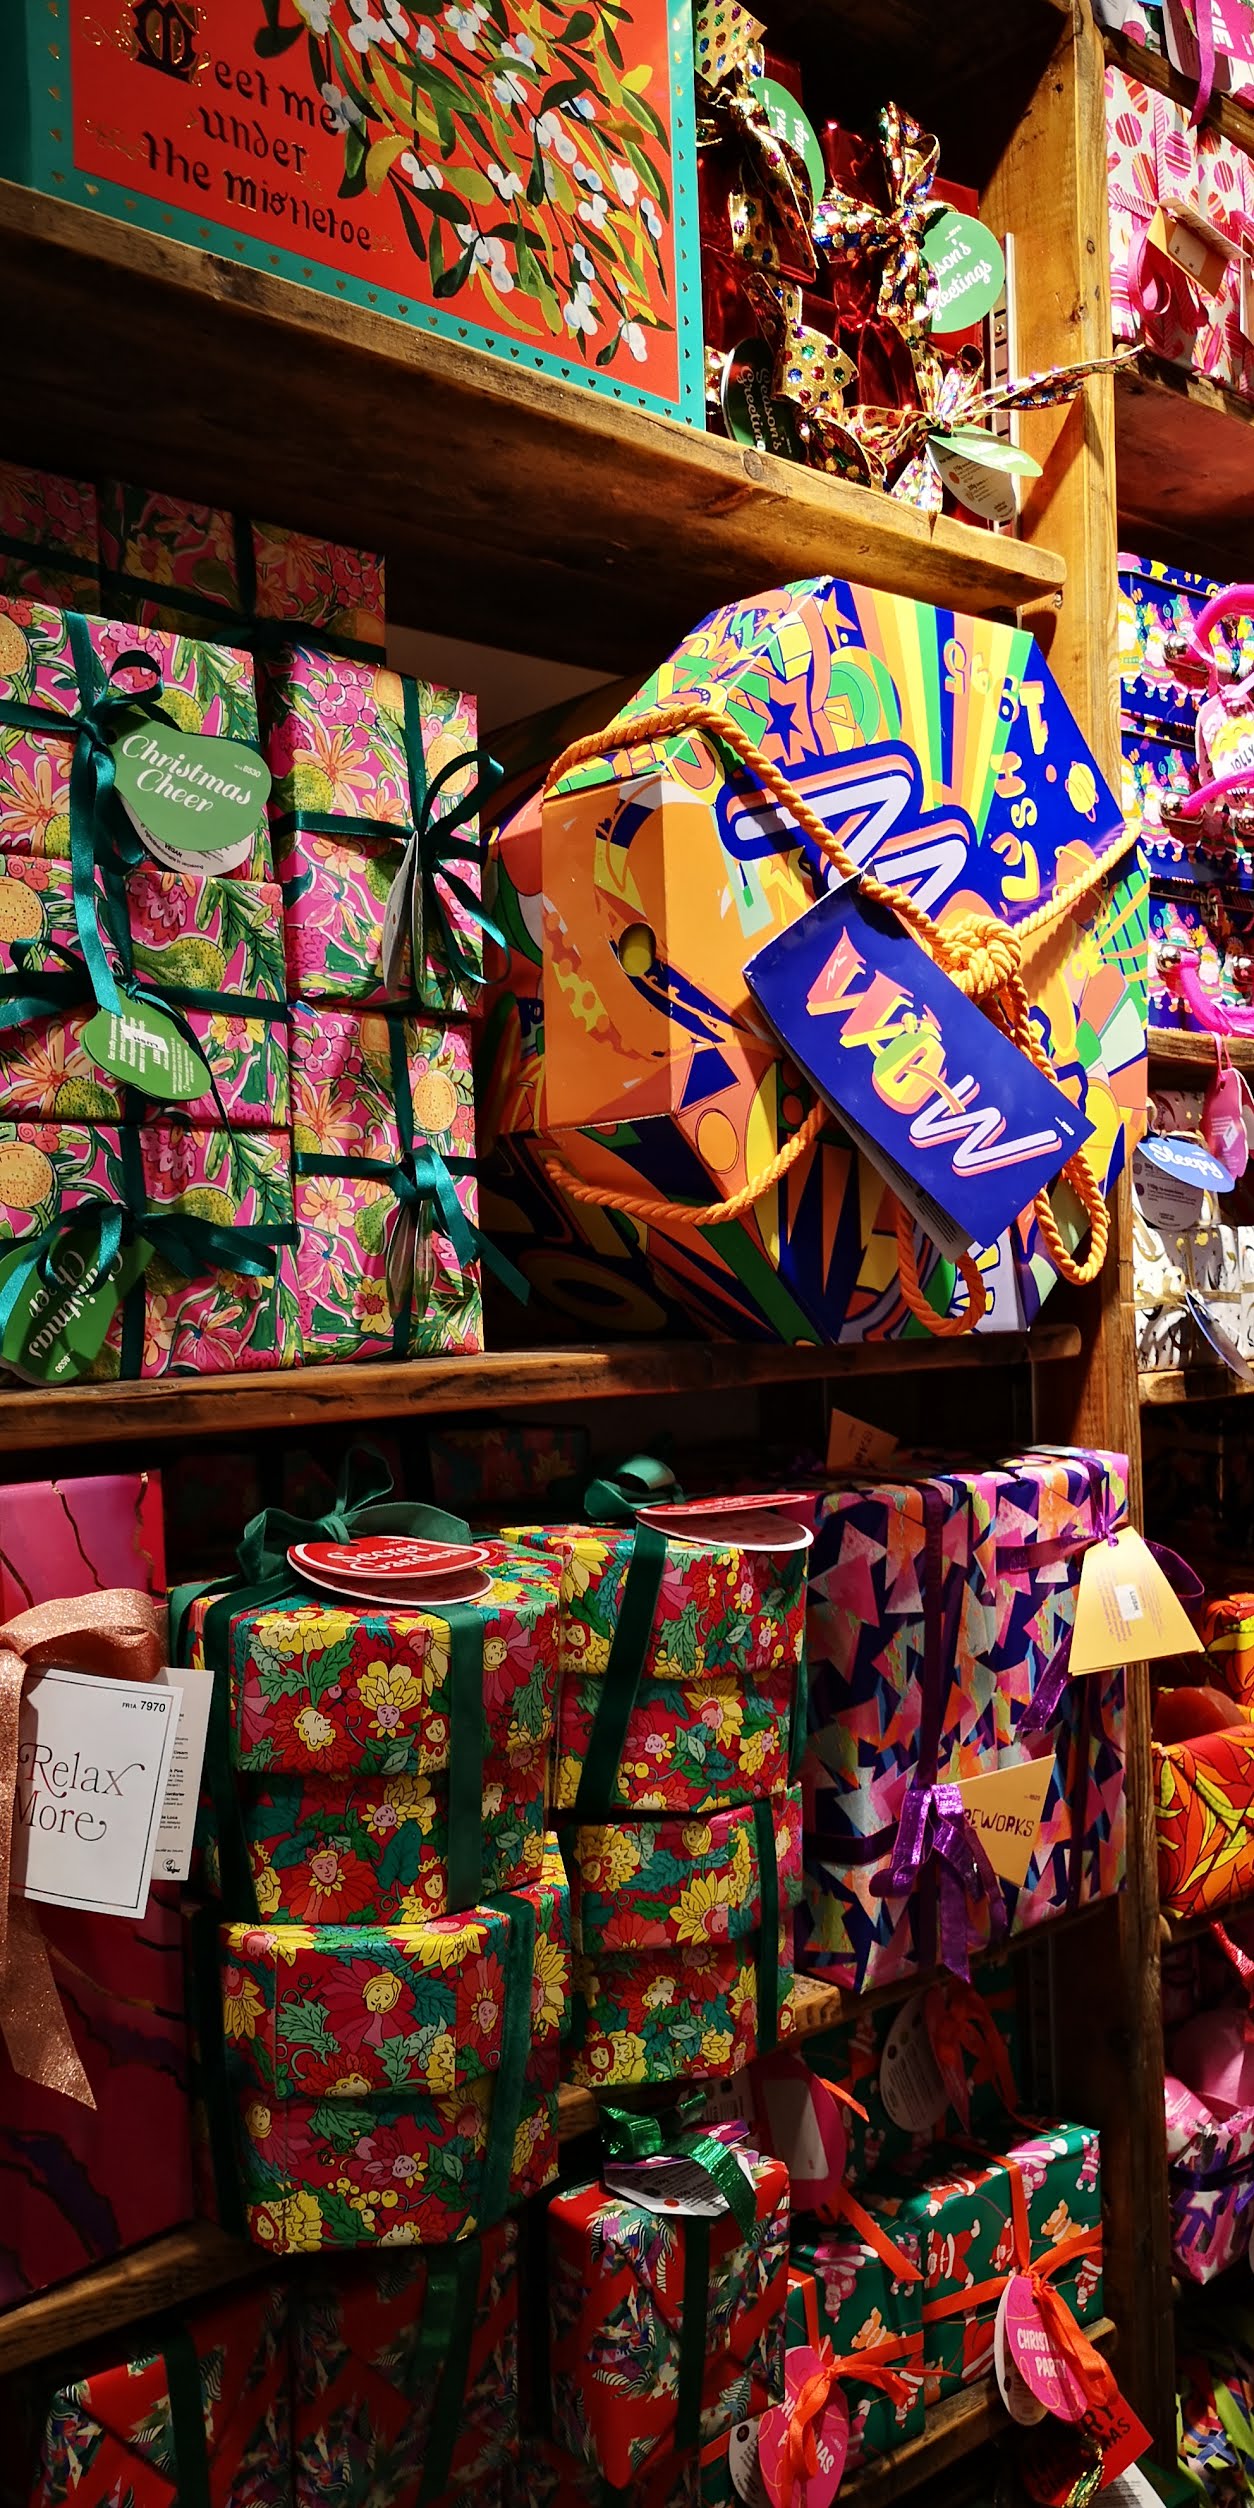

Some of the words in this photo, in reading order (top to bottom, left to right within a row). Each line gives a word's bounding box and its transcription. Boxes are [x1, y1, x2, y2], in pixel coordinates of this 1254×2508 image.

[131, 0, 270, 107] Meet
[279, 89, 340, 136] me
[198, 104, 310, 176] under
[143, 130, 212, 192] the
[223, 168, 373, 253] mistletoe
[935, 238, 972, 277] son's
[736, 365, 767, 453] Greetin
[756, 367, 783, 451] Season's
[122, 734, 251, 806] Christmas
[137, 768, 214, 813] Cheer
[164, 843, 184, 859] VEGAN
[806, 926, 1063, 1179] WOW
[1148, 1141, 1225, 1183] Sleepy
[326, 1543, 431, 1565] Secret
[349, 1548, 470, 1572] Garden
[1129, 1590, 1140, 1611] LUSH
[140, 1700, 166, 1713] 7970
[18, 1742, 146, 1799] Relax
[963, 1808, 1035, 1838] EWORKS
[1016, 2327, 1056, 2353] CHRIST
[1034, 2356, 1068, 2379] PARTY
